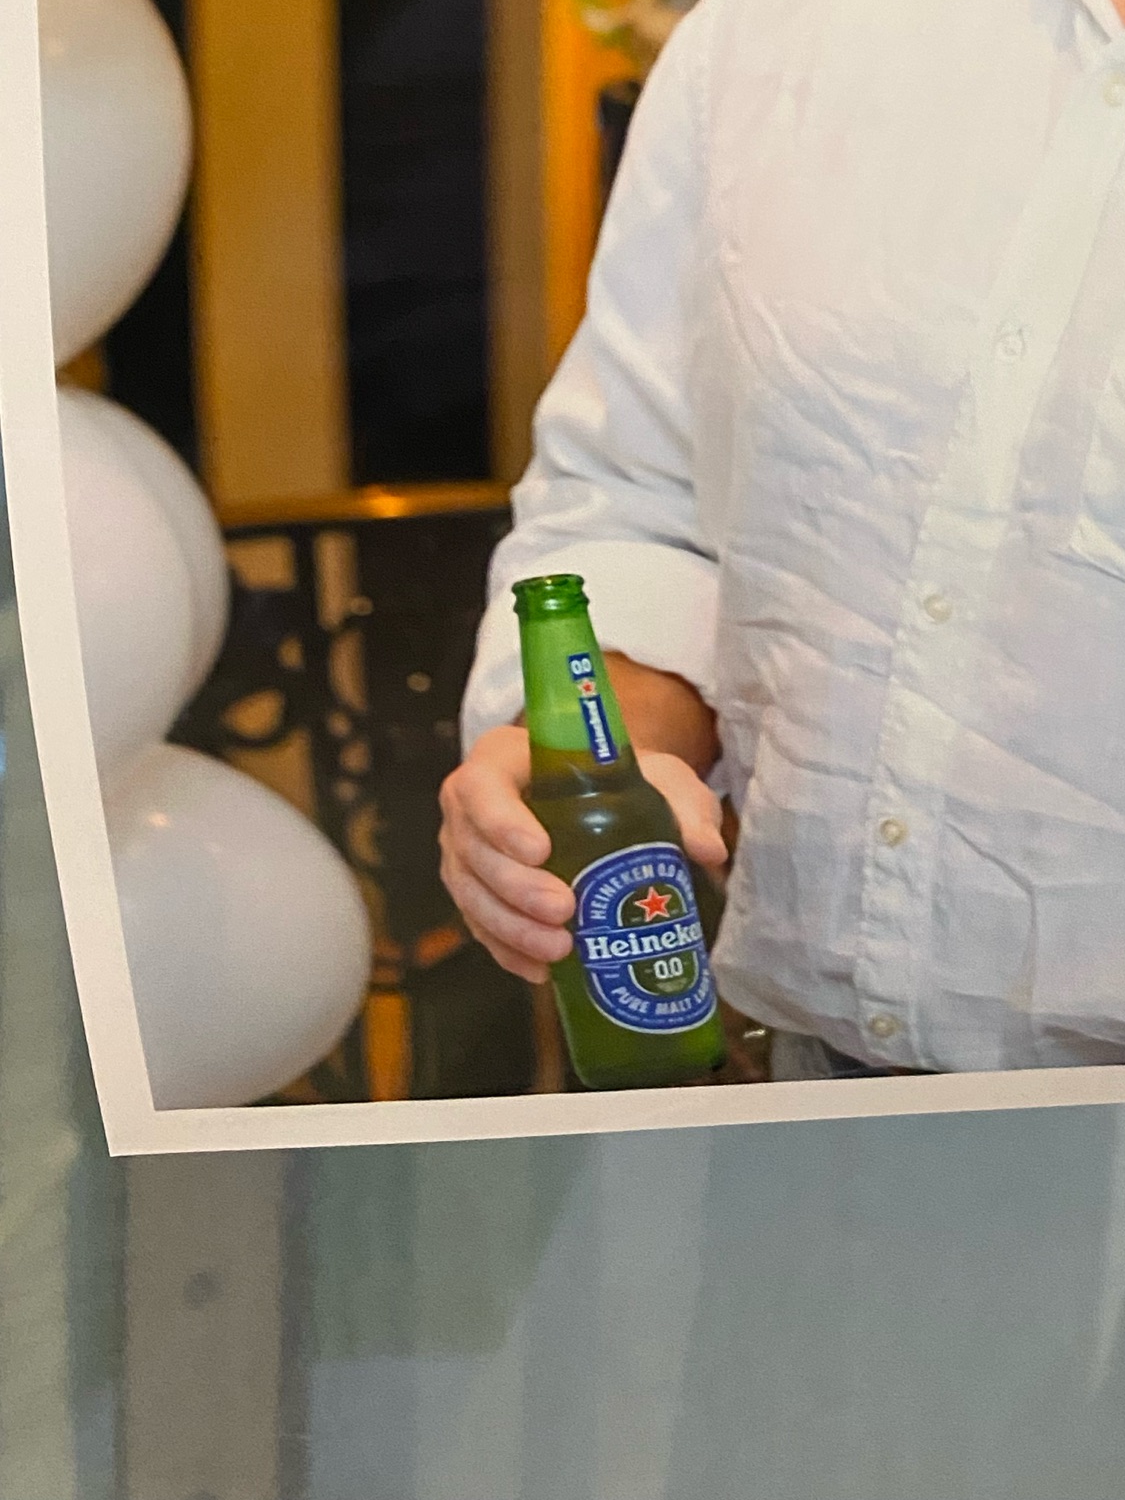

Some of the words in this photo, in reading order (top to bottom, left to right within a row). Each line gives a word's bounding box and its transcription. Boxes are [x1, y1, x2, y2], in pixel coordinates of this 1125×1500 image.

[590, 863, 656, 920] HEINEKEN
[653, 956, 684, 980] 0.0
[611, 986, 650, 1014] PURE
[655, 997, 692, 1015] MALT
